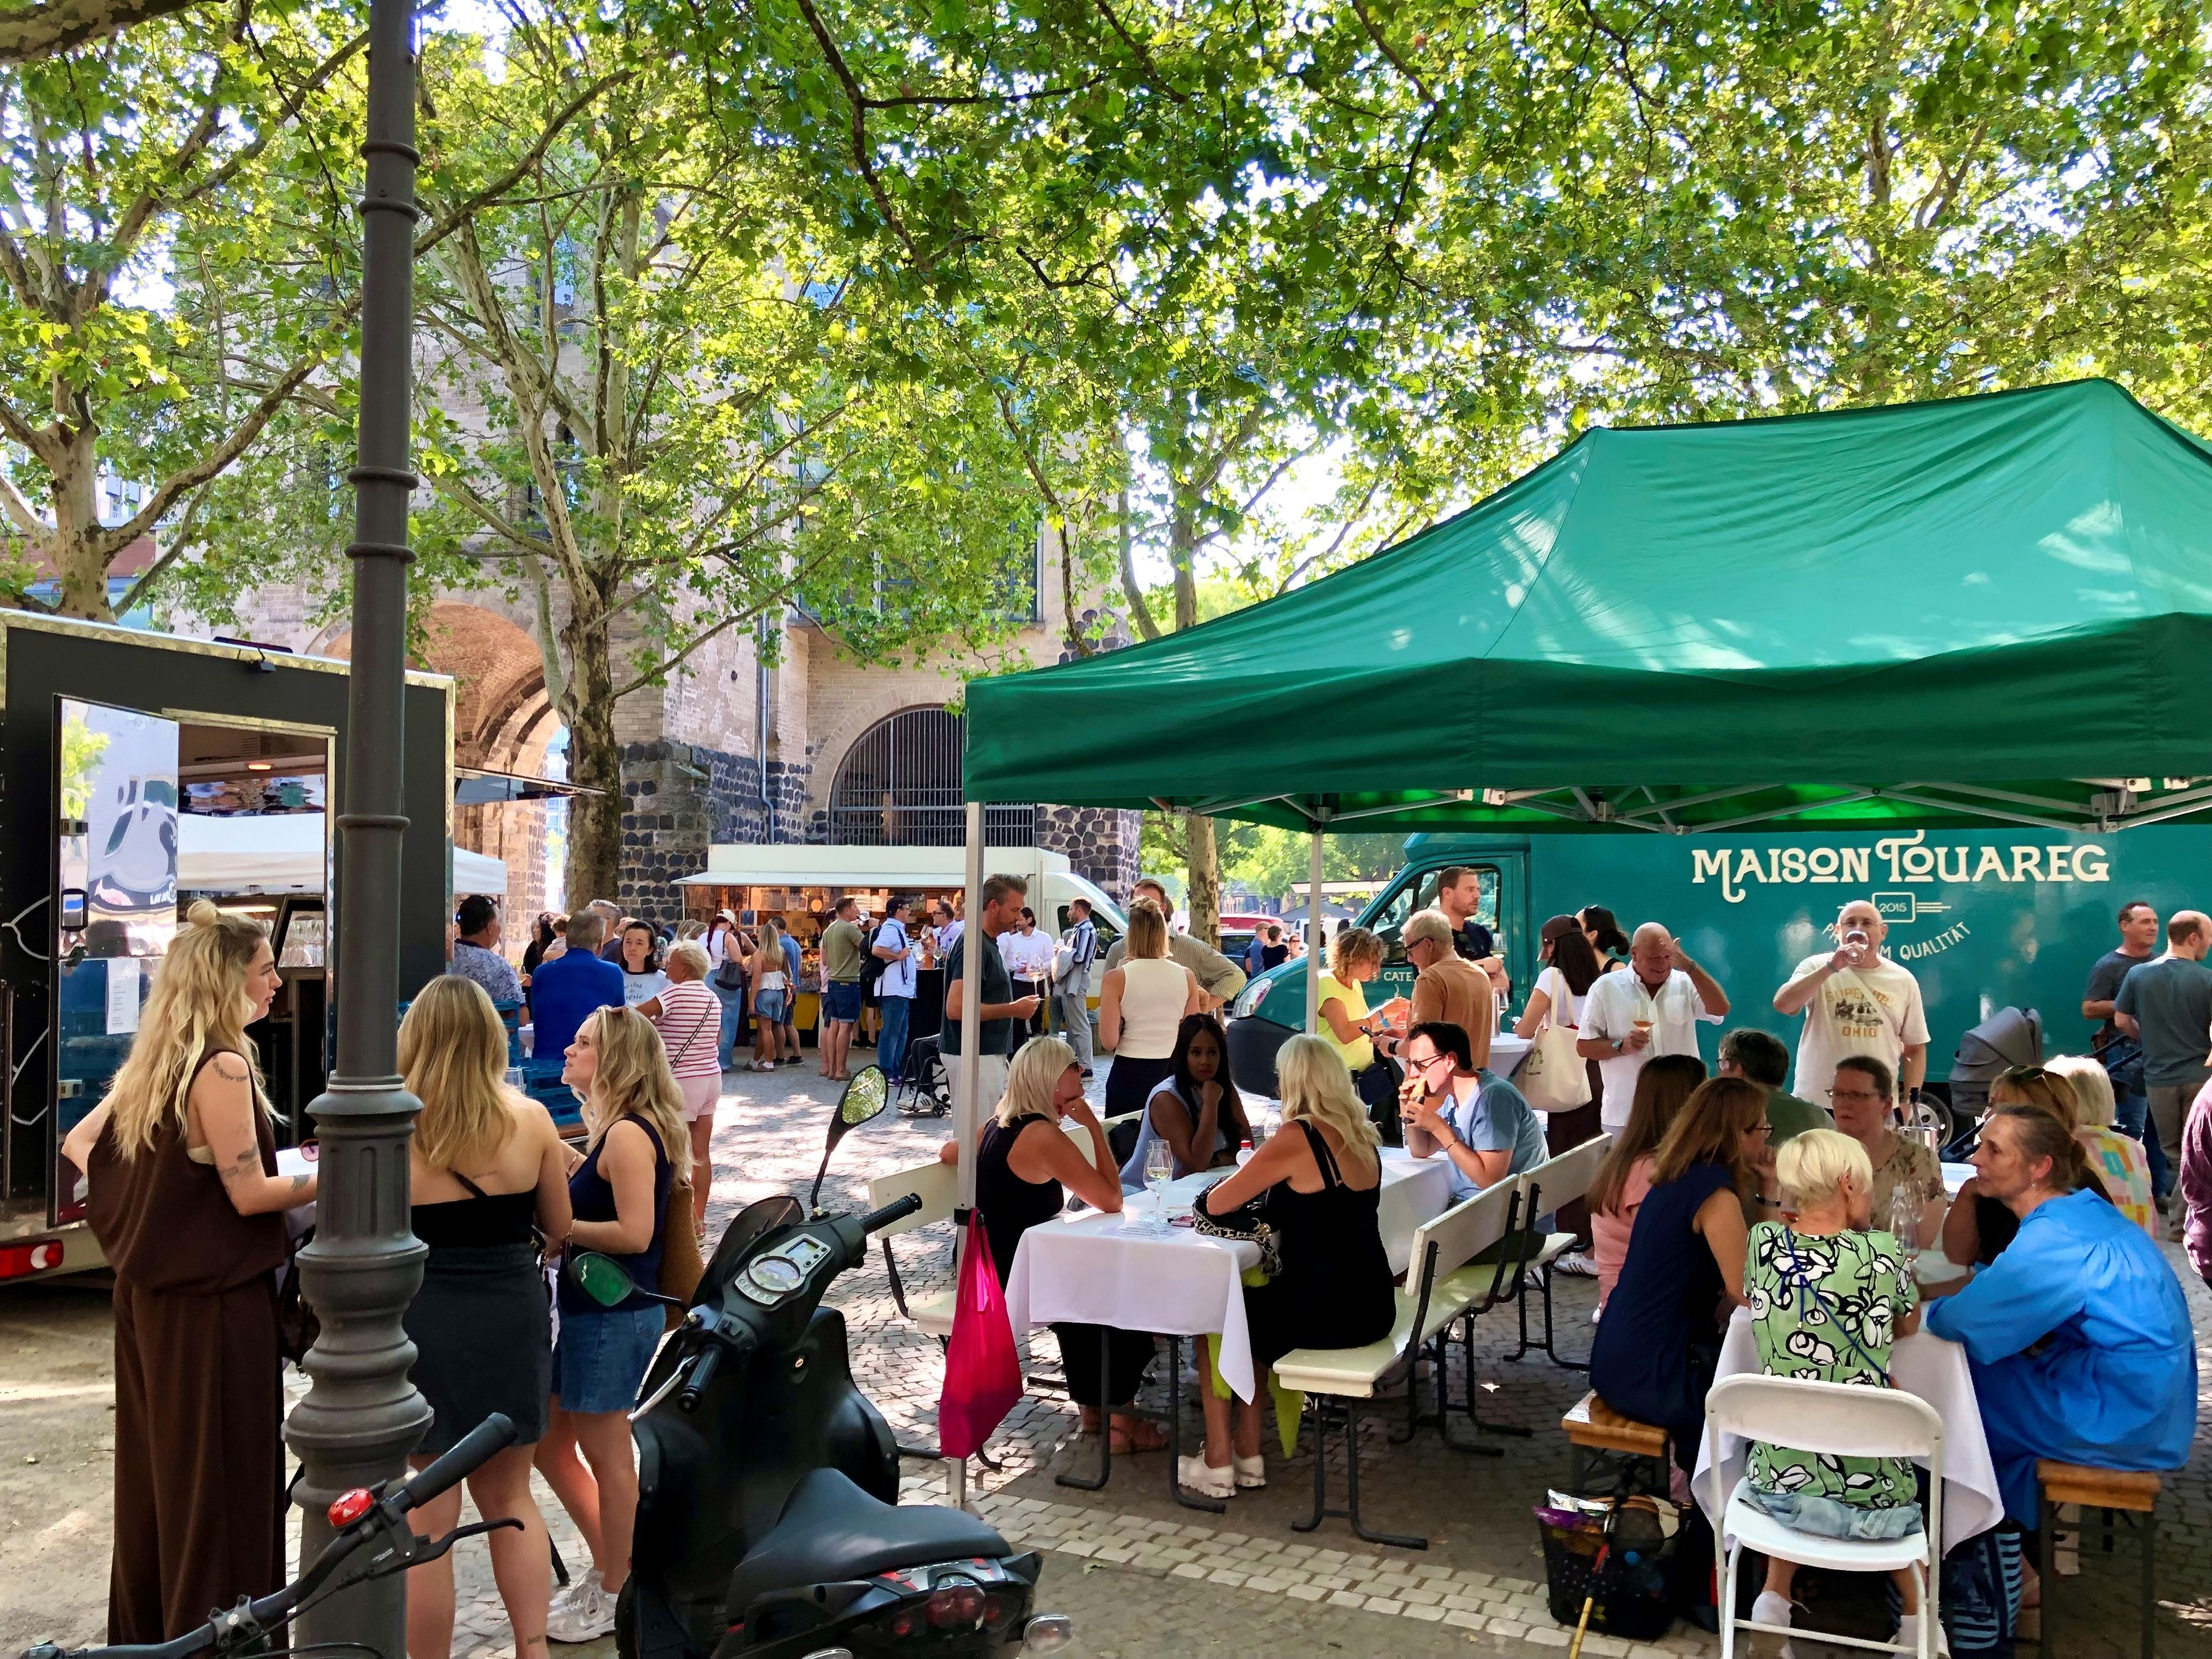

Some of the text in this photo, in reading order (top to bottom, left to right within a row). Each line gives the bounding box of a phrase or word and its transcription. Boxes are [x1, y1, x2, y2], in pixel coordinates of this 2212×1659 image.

[1692, 829, 2110, 904] MAISON TOUAREG
[1879, 902, 1907, 913] 2015
[1900, 921, 1971, 961] QUALITÄT
[1384, 972, 1416, 982] CATE
[1842, 1026, 1876, 1037] OHIO
